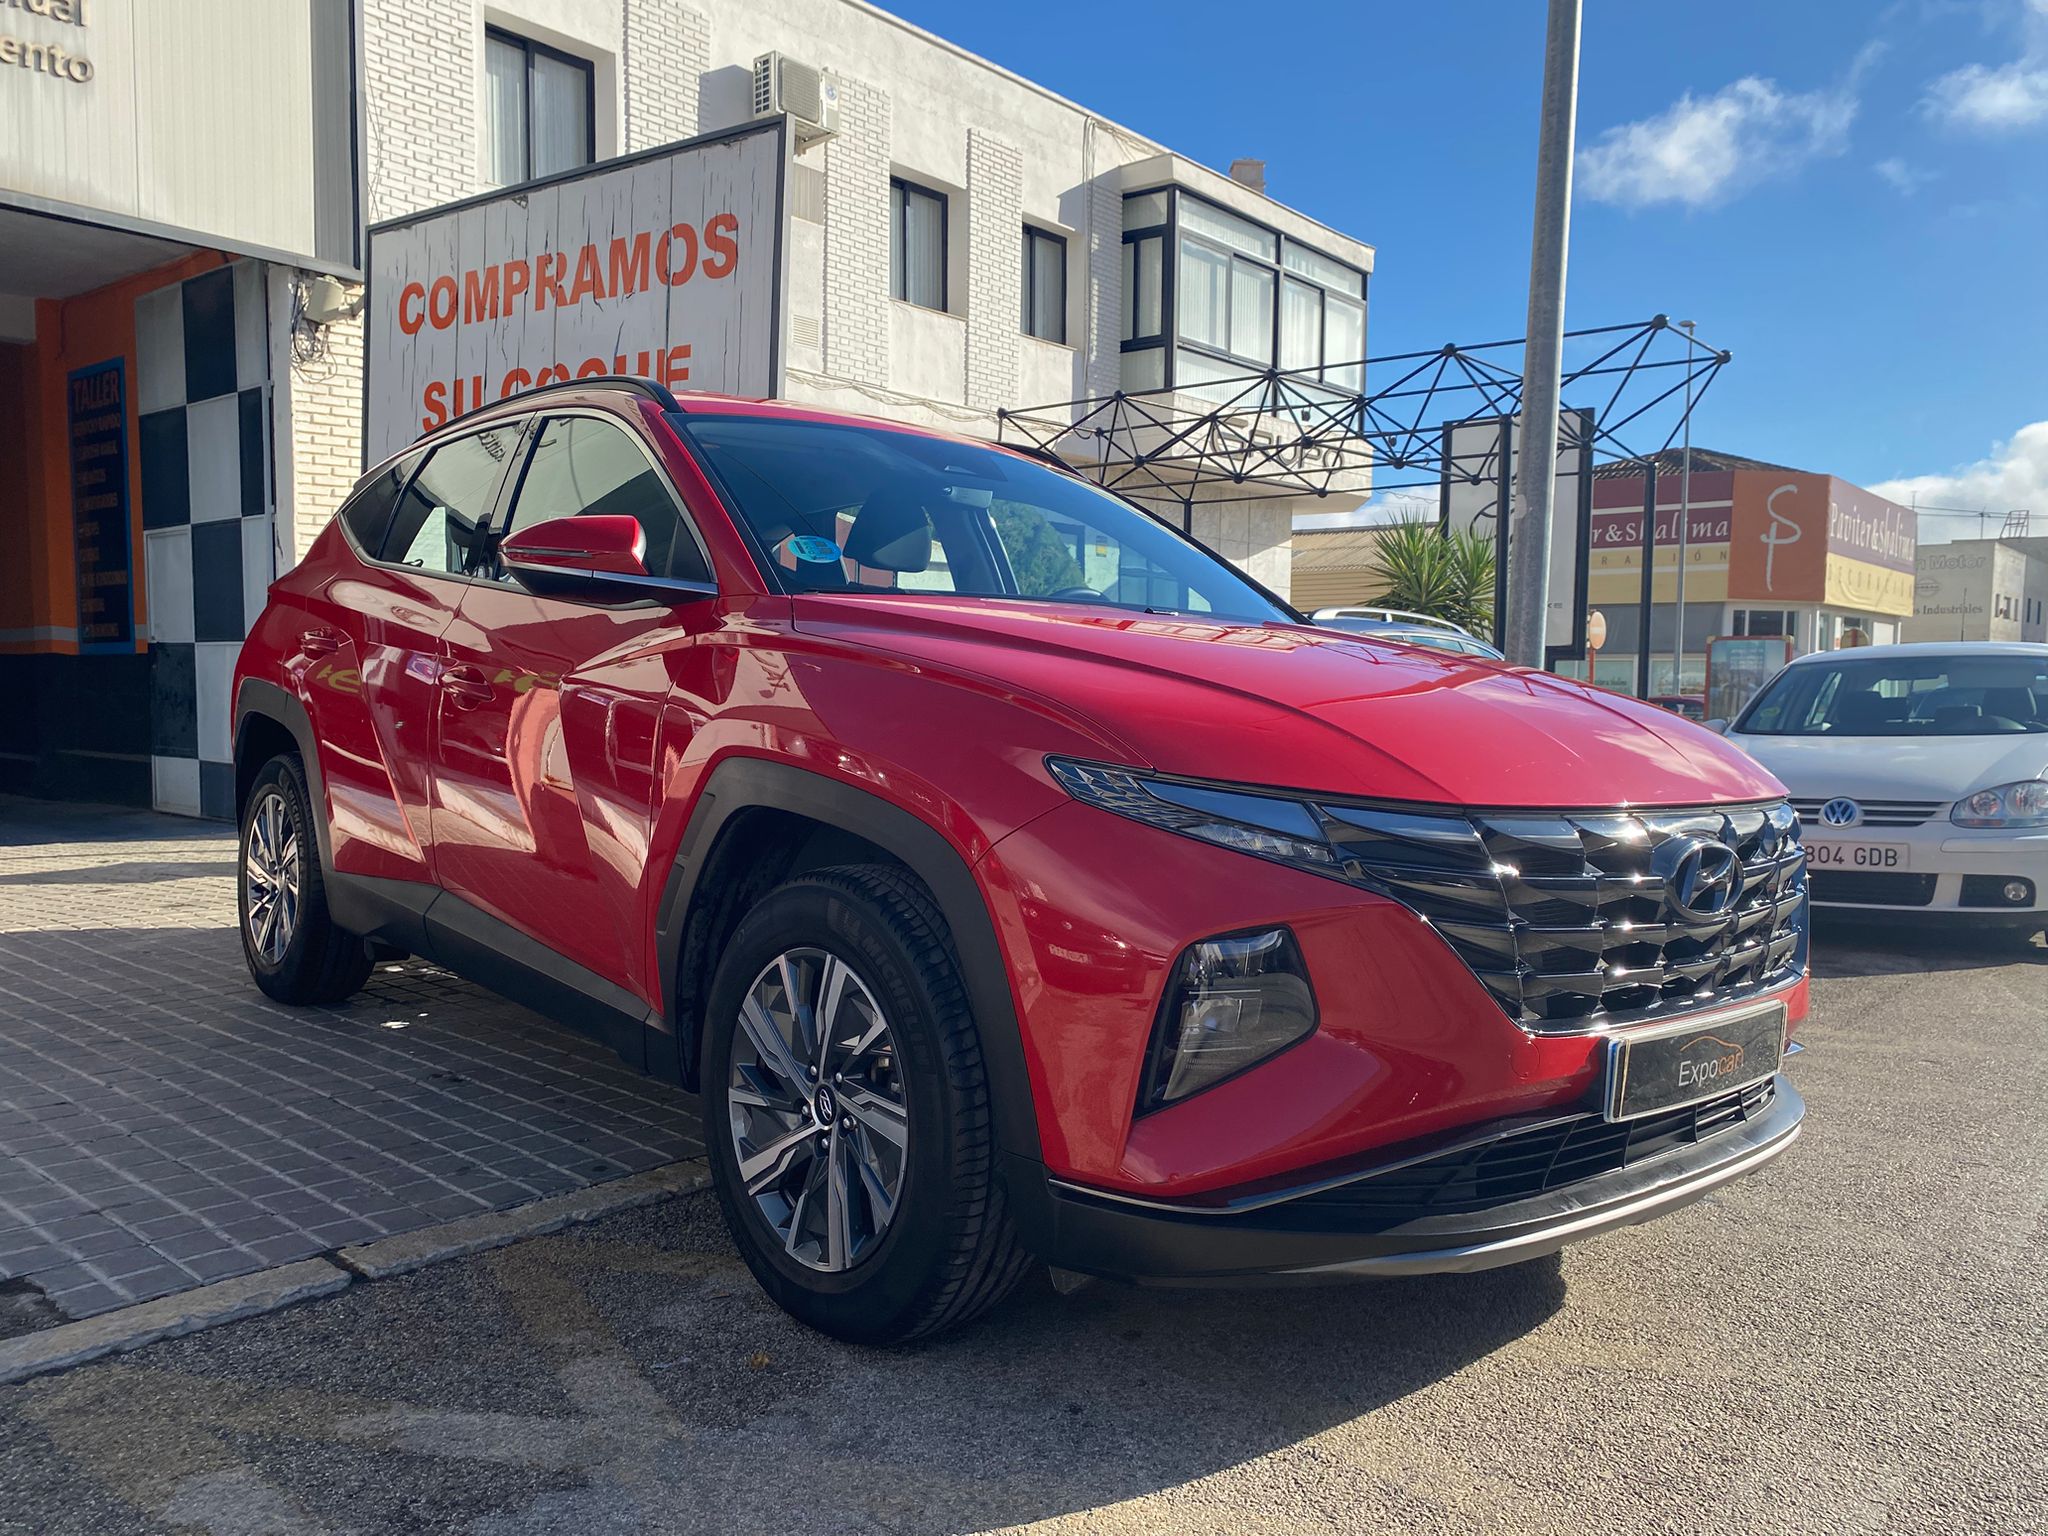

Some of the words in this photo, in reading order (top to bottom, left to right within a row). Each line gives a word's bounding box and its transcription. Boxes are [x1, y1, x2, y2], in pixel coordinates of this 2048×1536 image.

[398, 213, 739, 335] COMPRAMOS
[1929, 554, 1987, 571] Motor
[1923, 603, 1984, 615] Industriales
[1805, 845, 1845, 864] 804
[1854, 847, 1898, 867] GDB
[1678, 1050, 1741, 1088] Expocar
